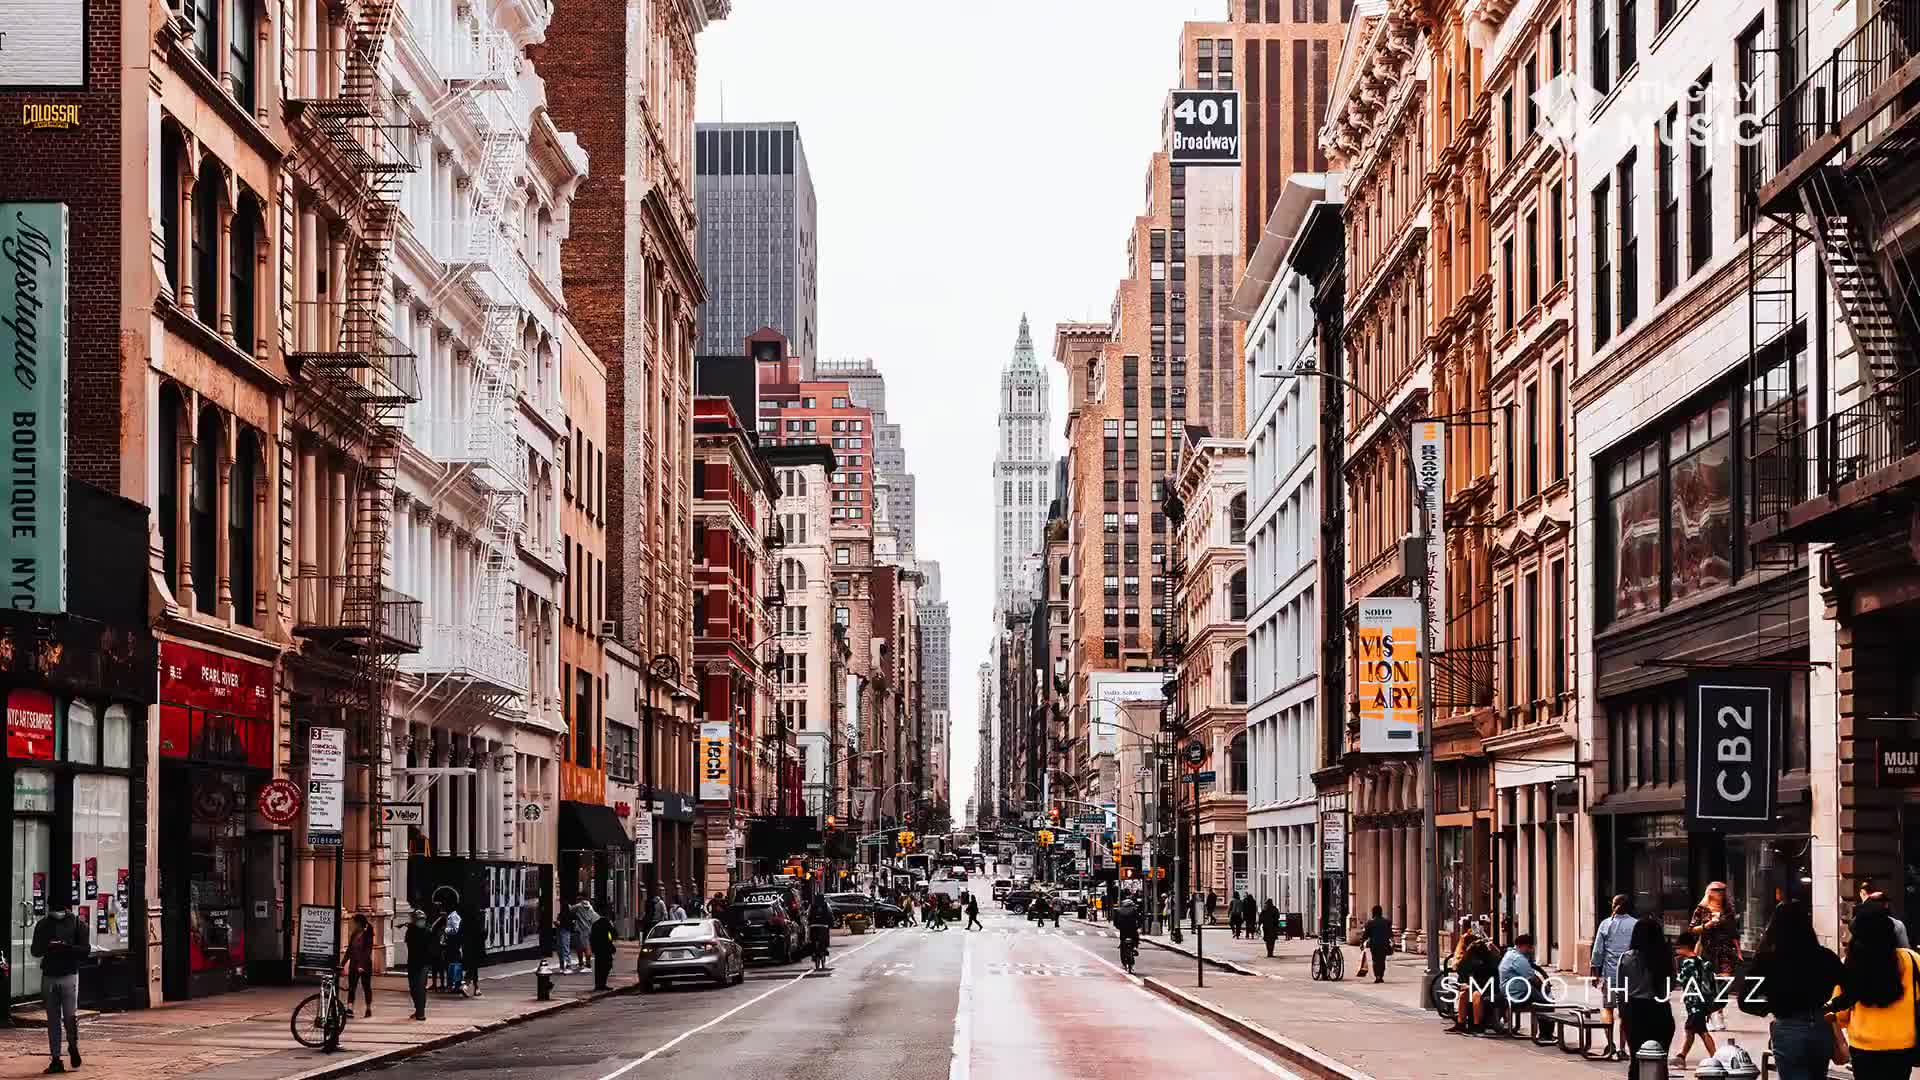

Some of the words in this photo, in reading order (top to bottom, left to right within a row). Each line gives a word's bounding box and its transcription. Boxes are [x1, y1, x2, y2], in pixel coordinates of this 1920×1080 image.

[23, 104, 80, 125] COLOSSAL
[1173, 98, 1233, 126] 401
[1174, 130, 1237, 155] Broadway
[2, 211, 52, 391] Mystique
[10, 411, 36, 539] BOUTIQUE
[10, 558, 36, 610] NYC
[1364, 608, 1392, 616] SOHO
[1361, 634, 1394, 658] VIS
[201, 666, 221, 683] PEARL
[221, 671, 239, 688] RIVER
[1368, 660, 1409, 683] ION
[1372, 687, 1416, 709] ARY
[313, 729, 319, 740] 3
[1716, 705, 1752, 802] CB2
[1884, 751, 1918, 766] MUJI
[311, 782, 318, 793] 2
[395, 809, 419, 821] Valley
[307, 909, 331, 917] better
